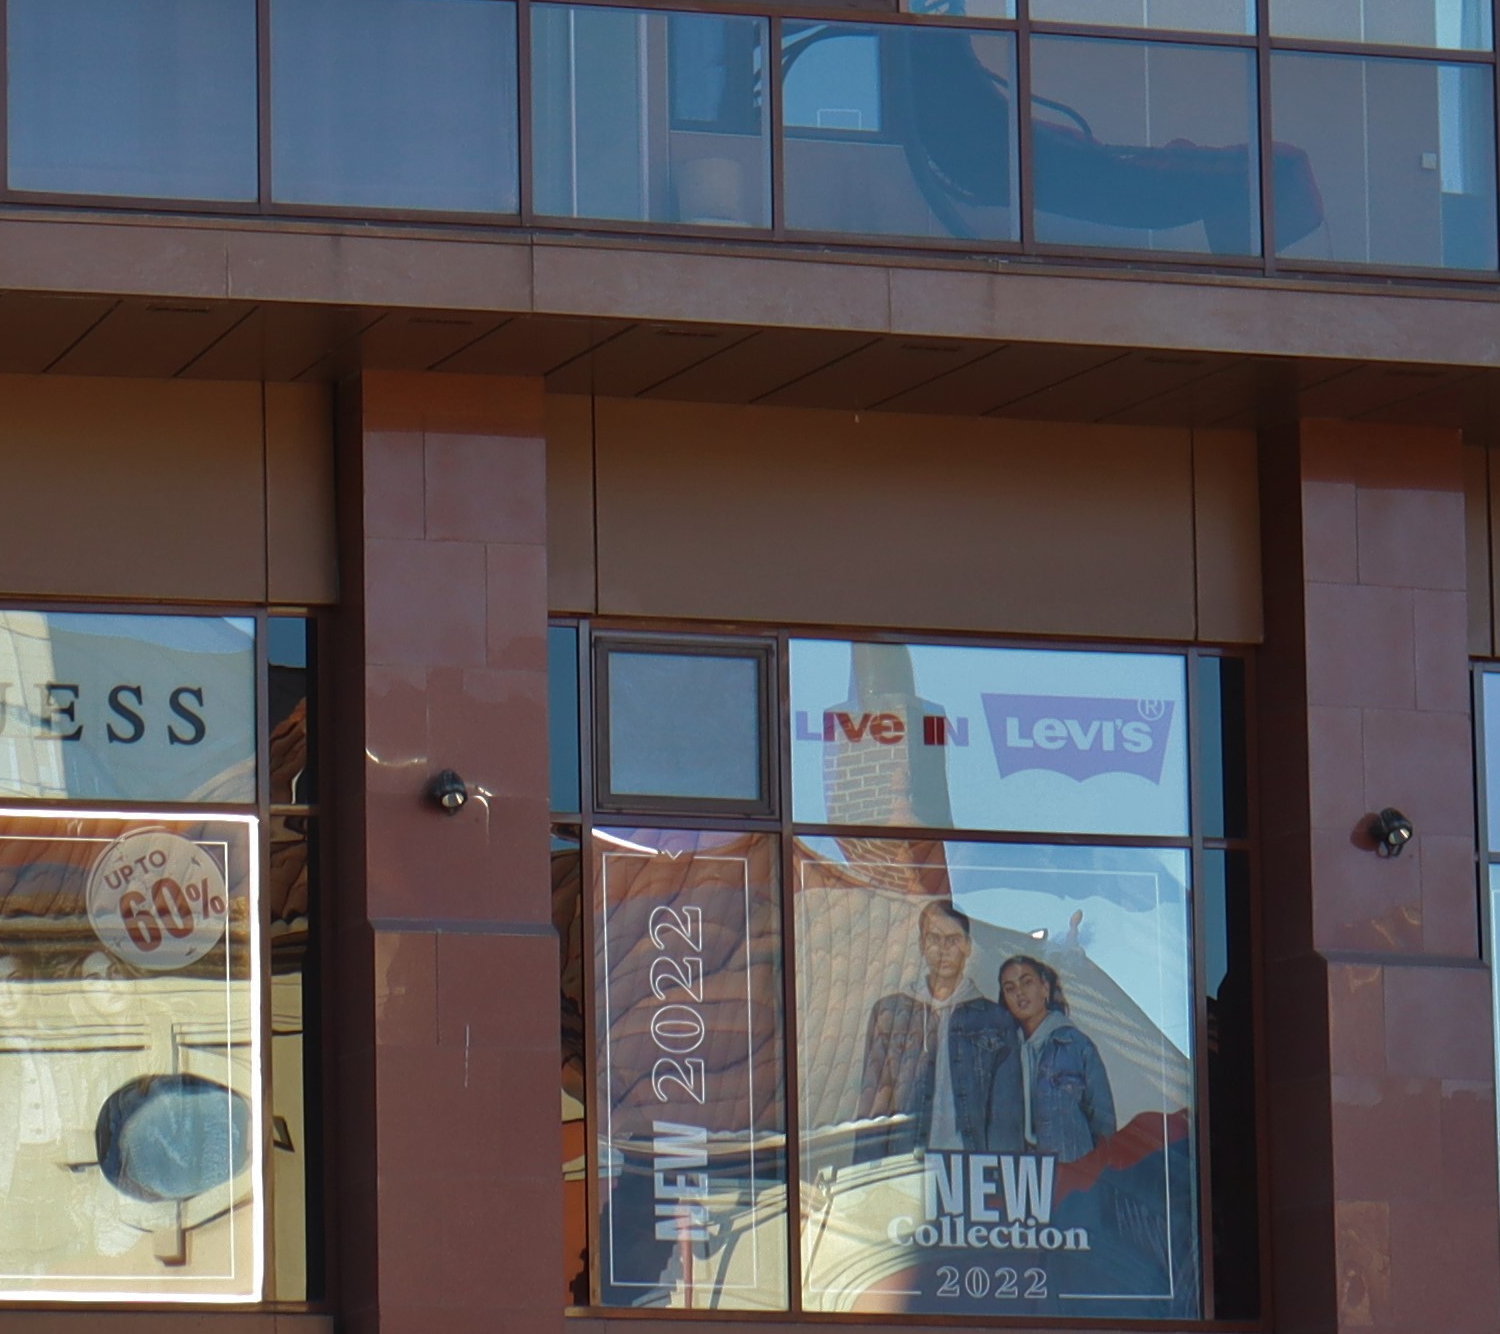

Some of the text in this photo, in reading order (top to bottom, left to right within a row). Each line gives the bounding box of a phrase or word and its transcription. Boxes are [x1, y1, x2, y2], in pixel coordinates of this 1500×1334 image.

[103, 849, 167, 890] UP TO
[119, 877, 227, 953] 60%
[648, 905, 711, 1242] NEW 2022
[923, 1152, 1056, 1224] NEW
[887, 1215, 1091, 1250] Collection
[936, 1265, 1048, 1299] 2022
